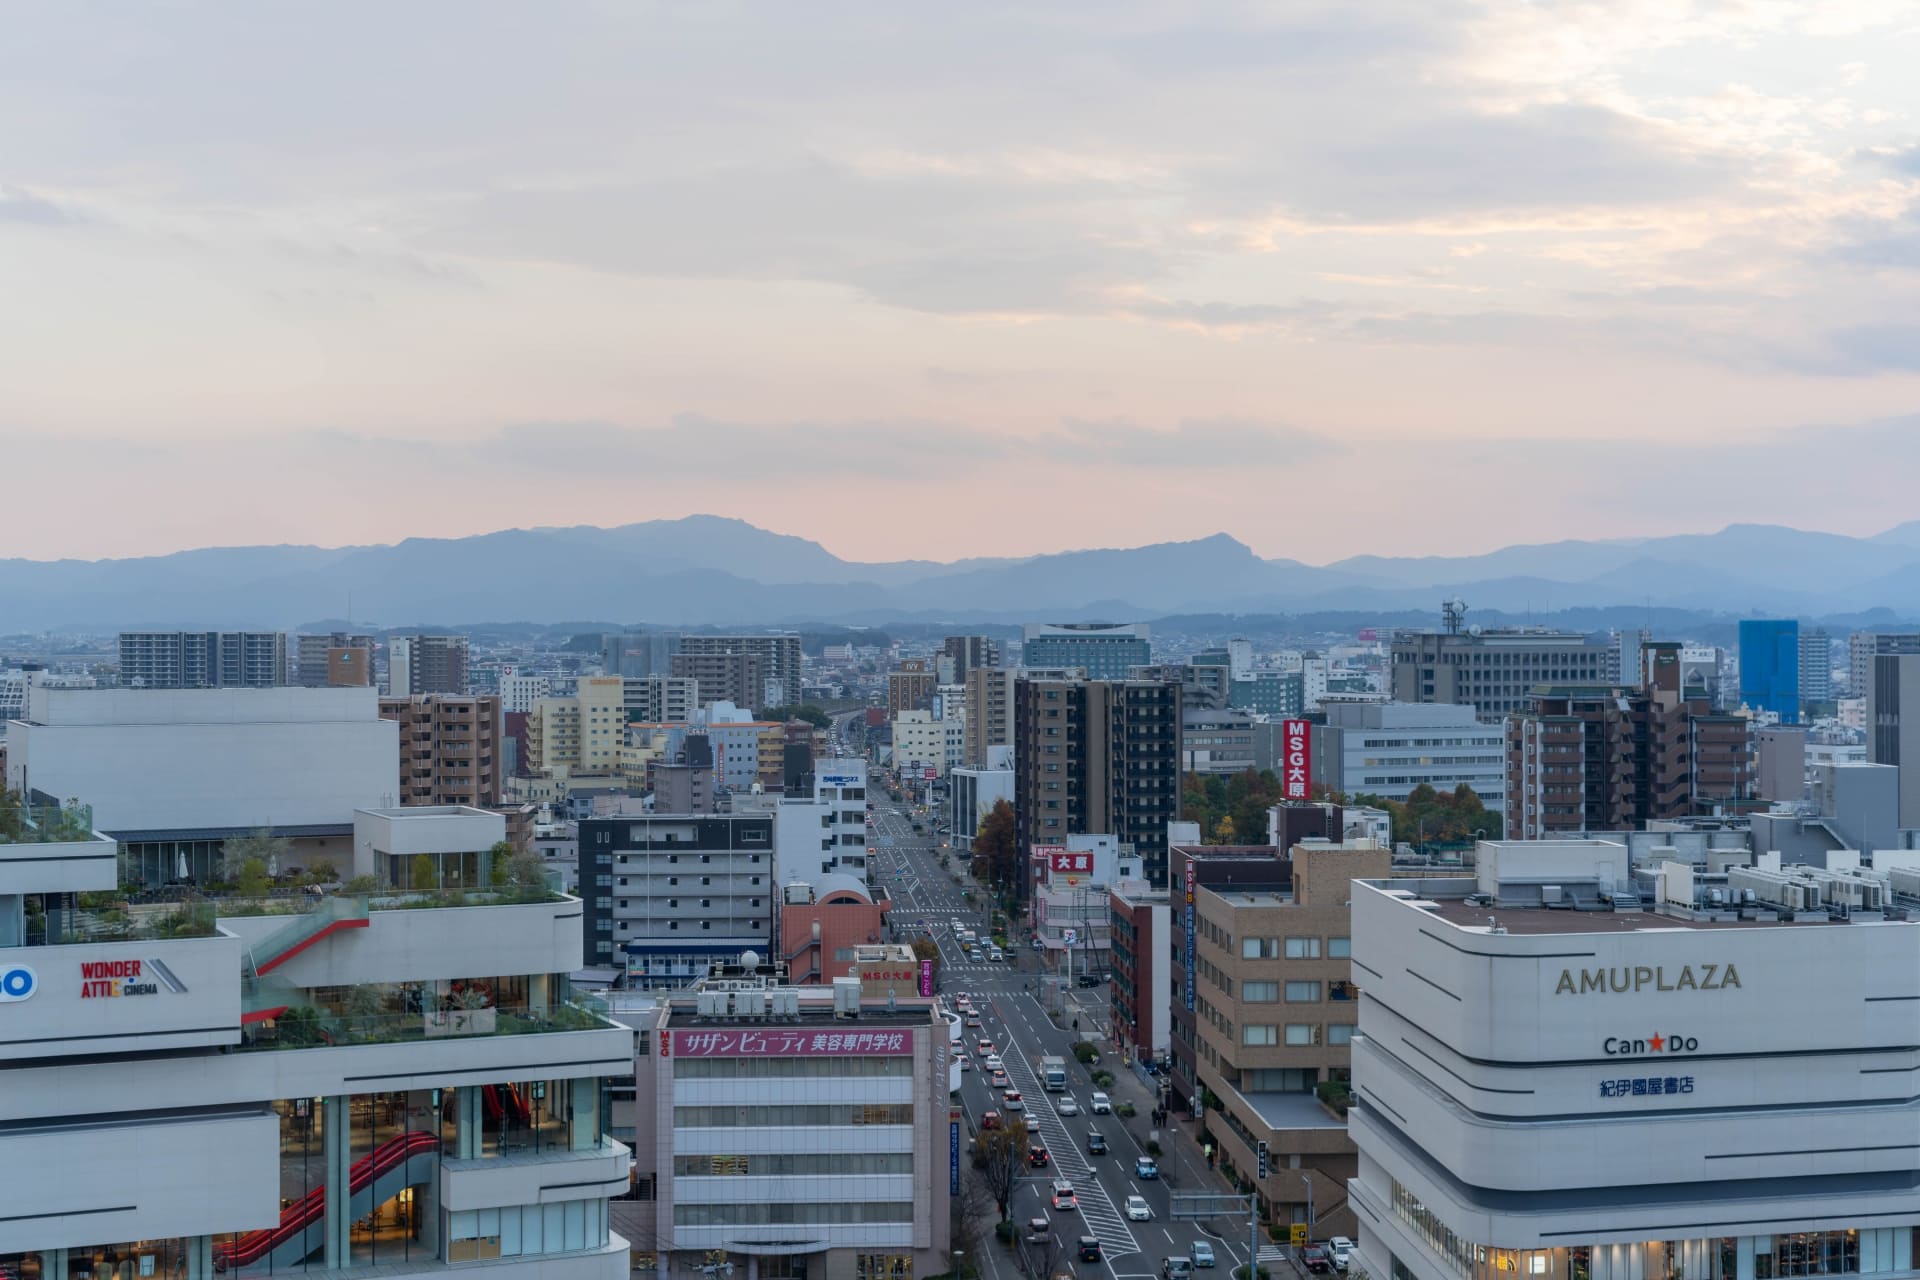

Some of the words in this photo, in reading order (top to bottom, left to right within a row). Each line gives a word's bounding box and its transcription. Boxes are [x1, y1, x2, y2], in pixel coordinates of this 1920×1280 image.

[1289, 722, 1305, 797] MSG大原
[1058, 856, 1087, 869] 大原
[81, 960, 141, 979] WONDER
[1555, 964, 1742, 995] AMUPLAZA
[0, 969, 33, 996] O
[81, 979, 121, 998] ATTIC
[124, 984, 158, 996] CINEMA
[660, 1031, 670, 1057] MSG
[1600, 1076, 1694, 1098] 紀伊國屋書店
